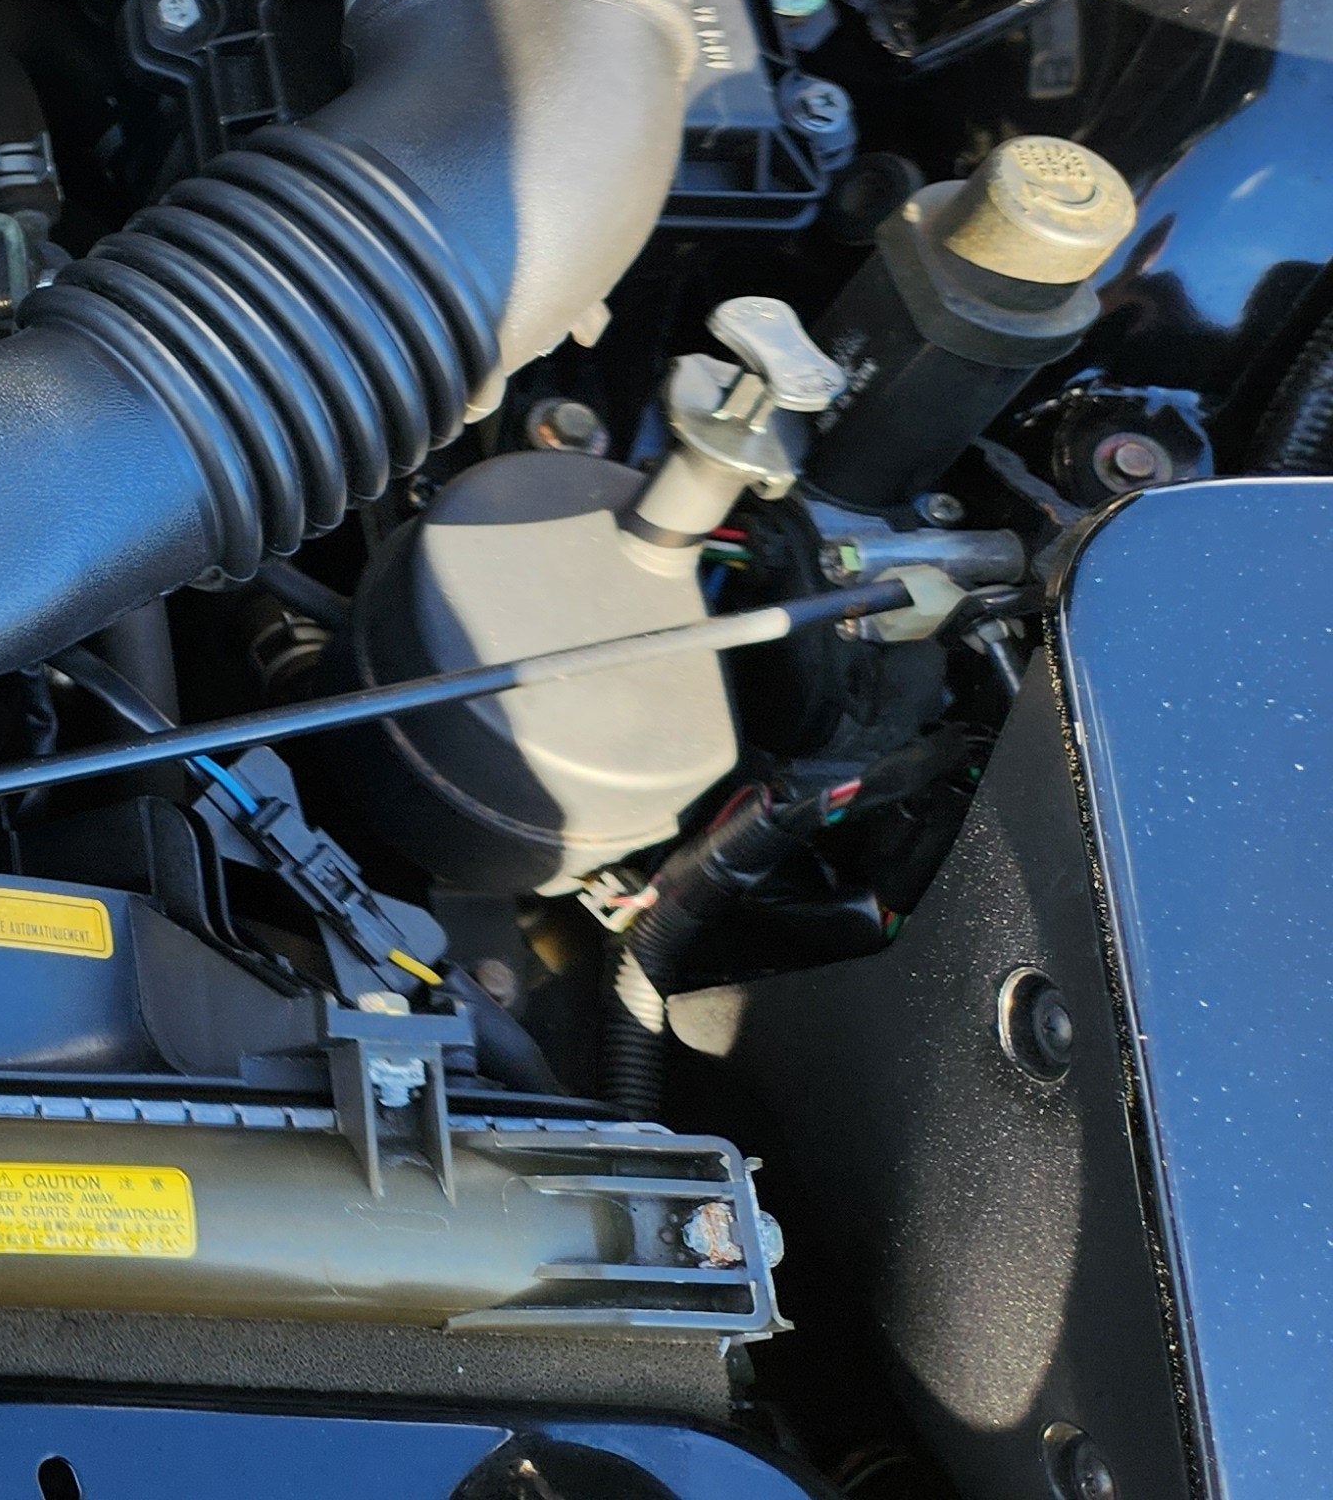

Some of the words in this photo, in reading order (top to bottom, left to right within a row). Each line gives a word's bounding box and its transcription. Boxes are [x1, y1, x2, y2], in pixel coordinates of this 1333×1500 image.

[22, 1174, 101, 1190] CAUTION
[29, 1191, 73, 1204] HANDS
[22, 1206, 71, 1217] STARTS
